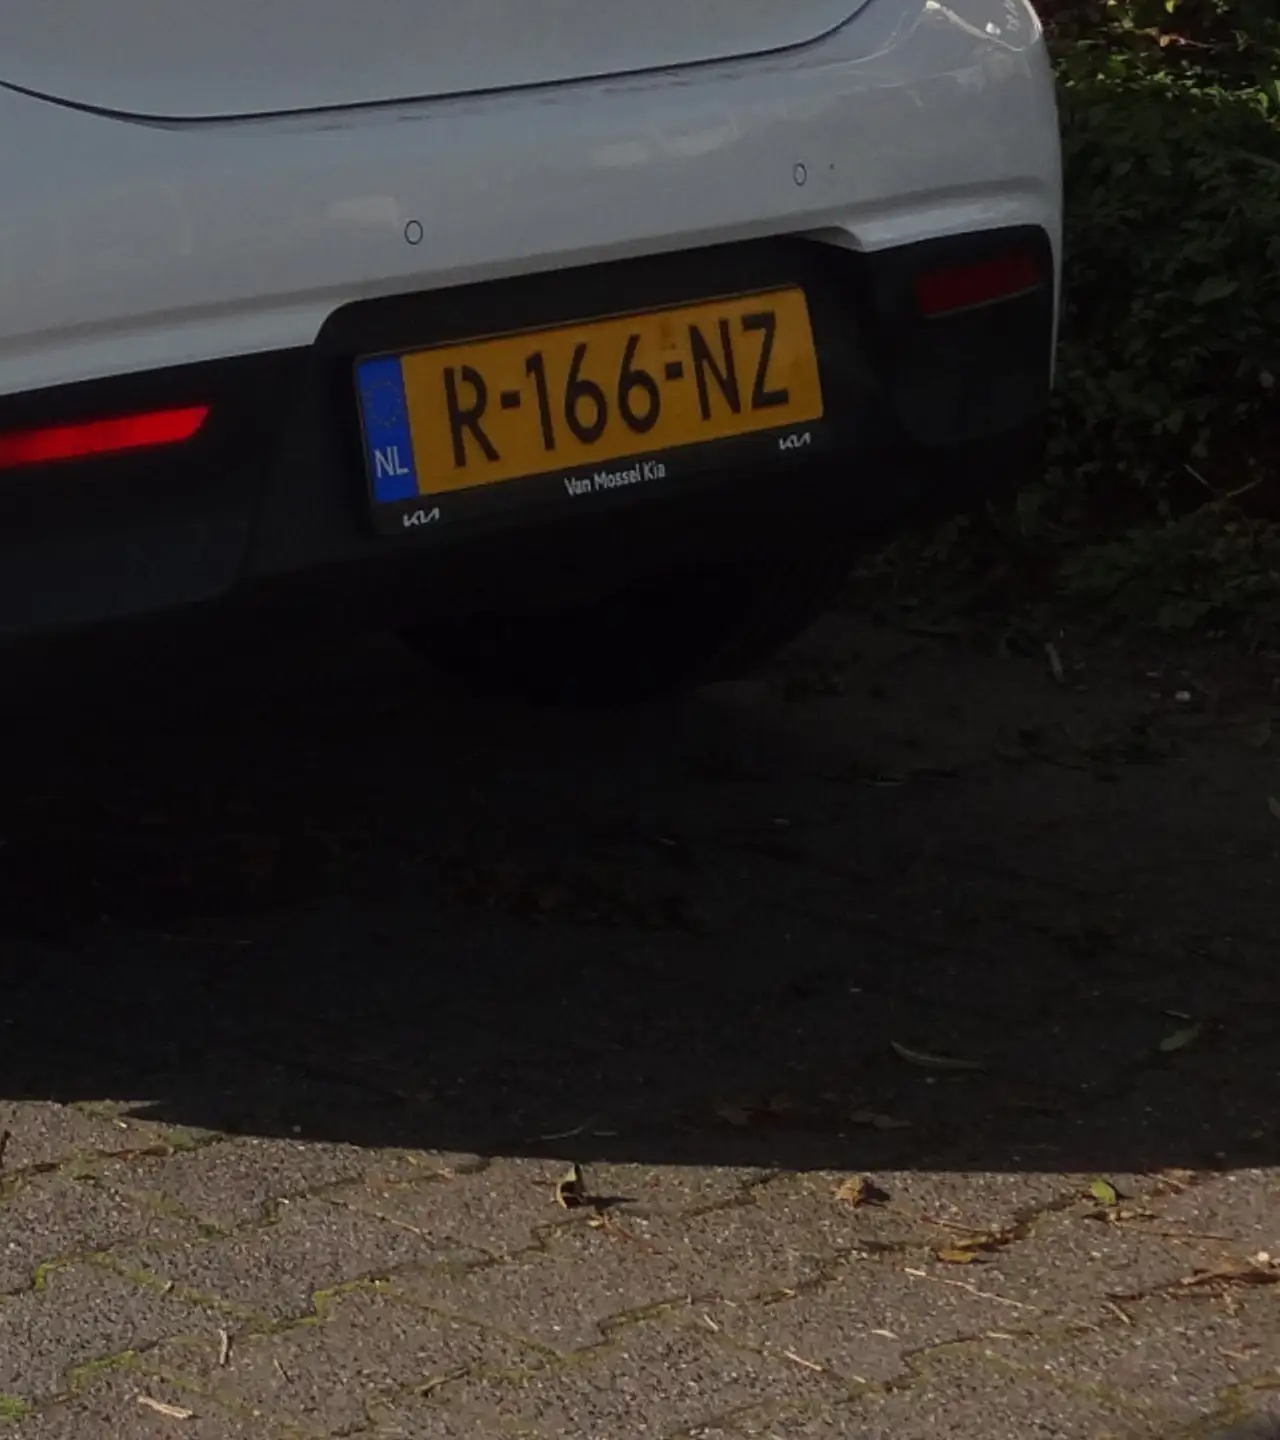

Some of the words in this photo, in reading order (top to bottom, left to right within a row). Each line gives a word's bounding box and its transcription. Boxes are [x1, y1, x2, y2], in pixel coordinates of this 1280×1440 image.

[443, 310, 790, 469] R-166-NZ
[777, 431, 812, 451] KIA
[373, 446, 410, 479] NL
[563, 474, 592, 497] Van
[593, 463, 642, 492] Mossel
[643, 460, 667, 482] Kia
[402, 507, 440, 529] KIA
